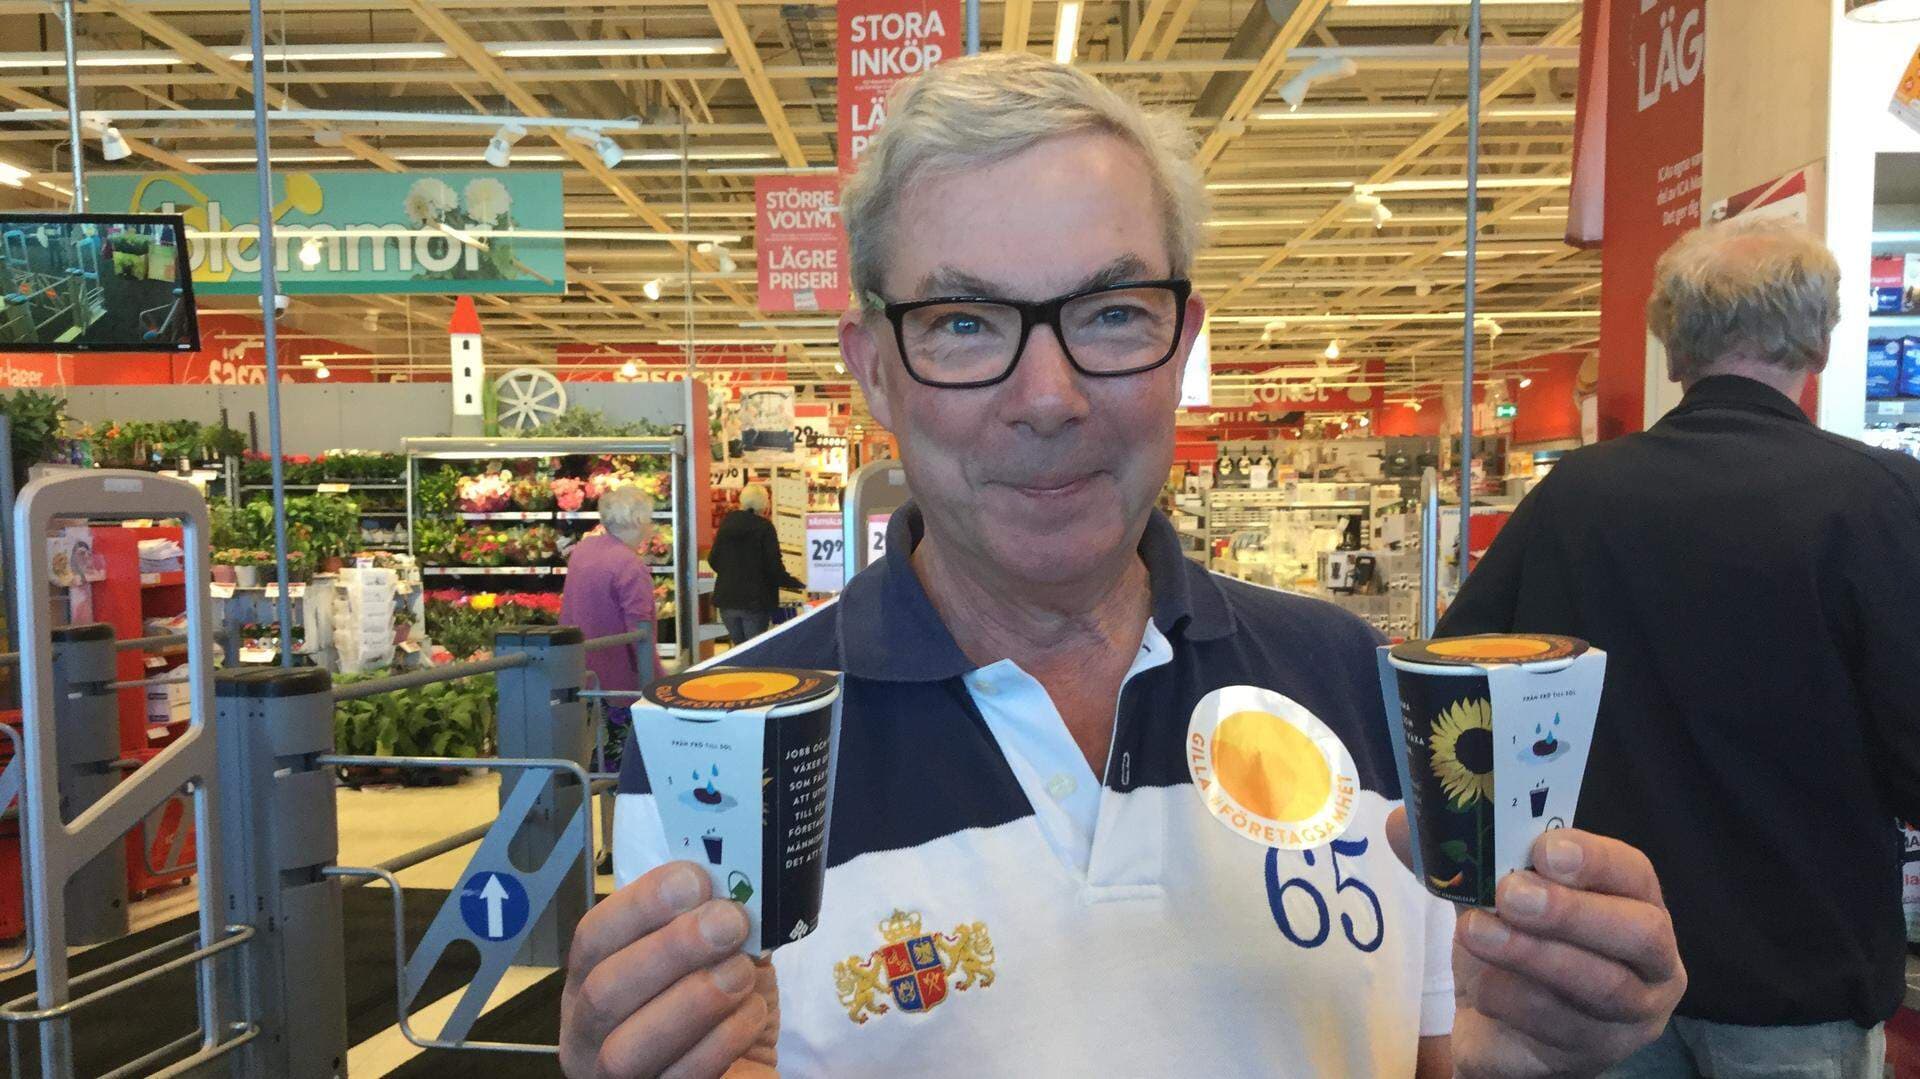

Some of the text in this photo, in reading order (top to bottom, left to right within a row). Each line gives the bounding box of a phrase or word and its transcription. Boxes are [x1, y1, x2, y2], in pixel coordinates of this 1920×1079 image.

[851, 10, 945, 42] STORA
[851, 38, 942, 77] INKÖP
[851, 96, 888, 132] LÄ
[766, 187, 834, 209] STÖRRE
[767, 211, 836, 229] VOLYM.
[162, 202, 493, 273] blommor
[768, 246, 838, 270] LÄGRE
[768, 272, 838, 290] PRISER!
[873, 531, 887, 550] 2
[1190, 732, 1213, 792] GILLA
[789, 777, 811, 792] SOM
[1265, 836, 1384, 953] 65
